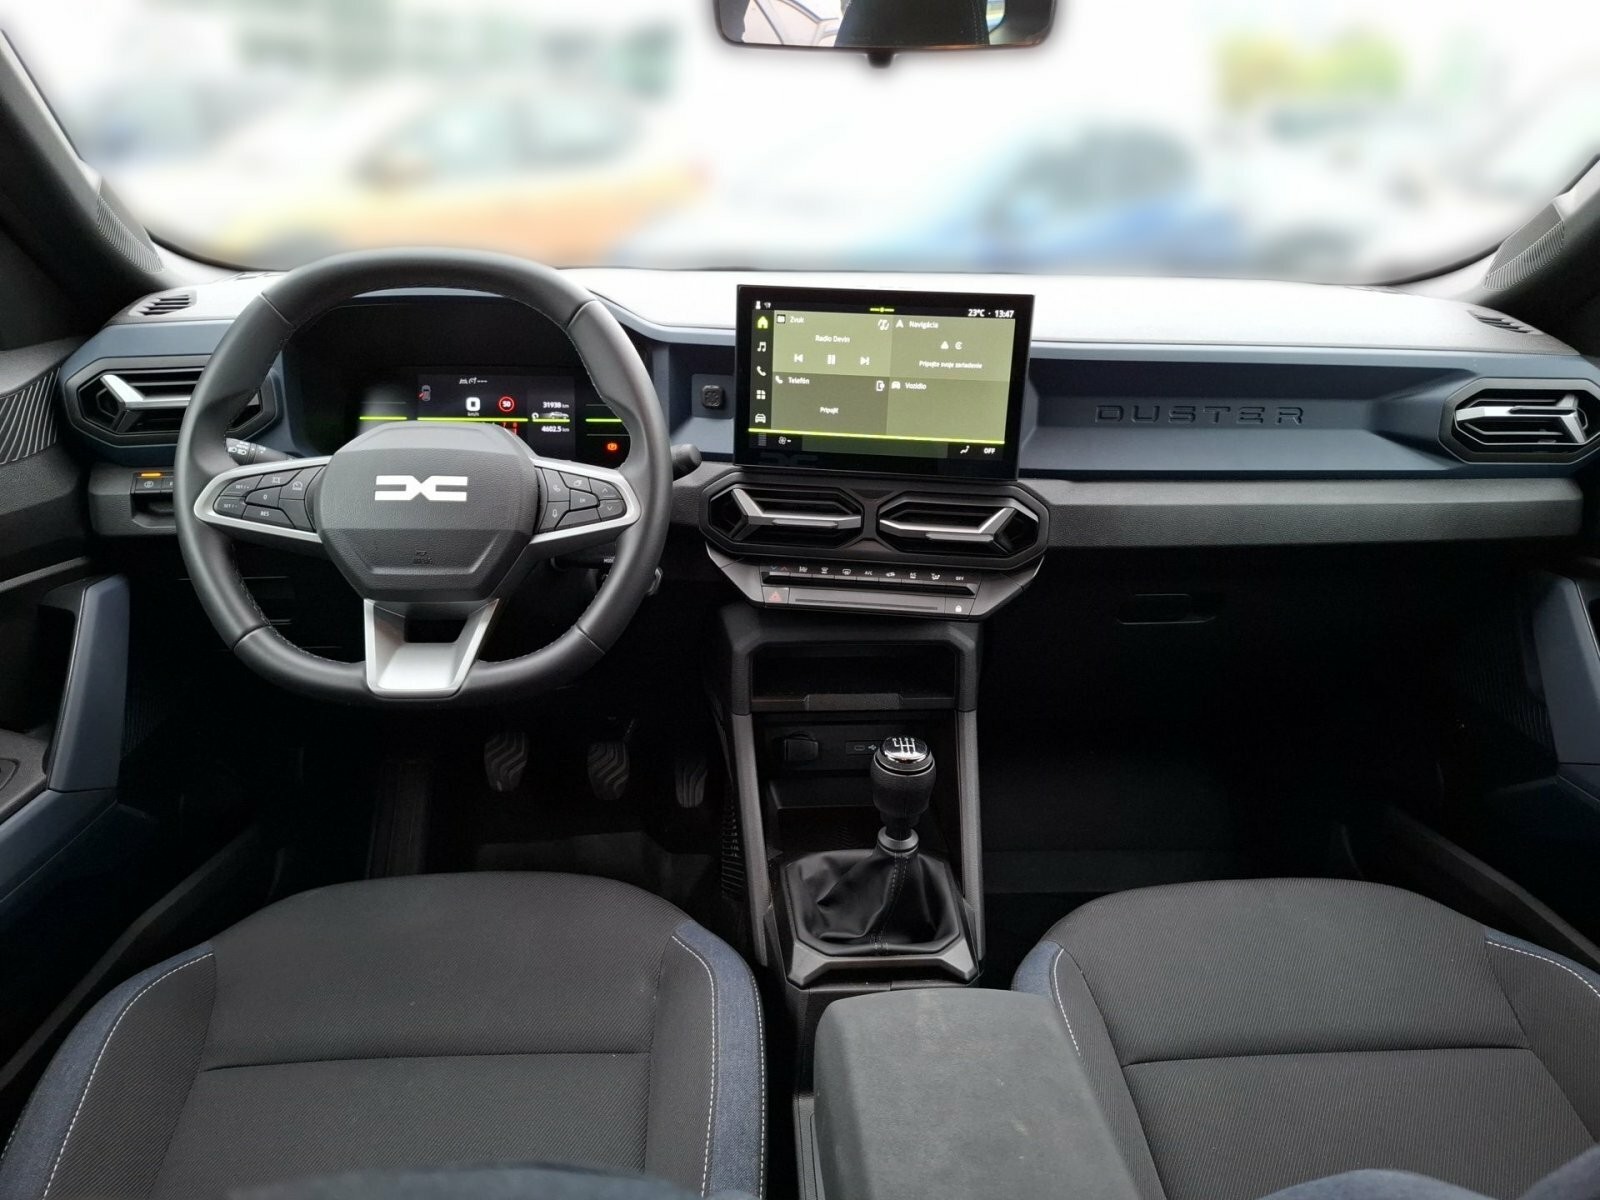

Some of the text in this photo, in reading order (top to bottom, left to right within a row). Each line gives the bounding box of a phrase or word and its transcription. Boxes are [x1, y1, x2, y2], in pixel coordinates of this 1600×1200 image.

[967, 308, 1015, 318] 23°C 13:47
[502, 400, 512, 408] 50
[1095, 404, 1304, 425] DUSTER
[983, 447, 996, 455] OFF
